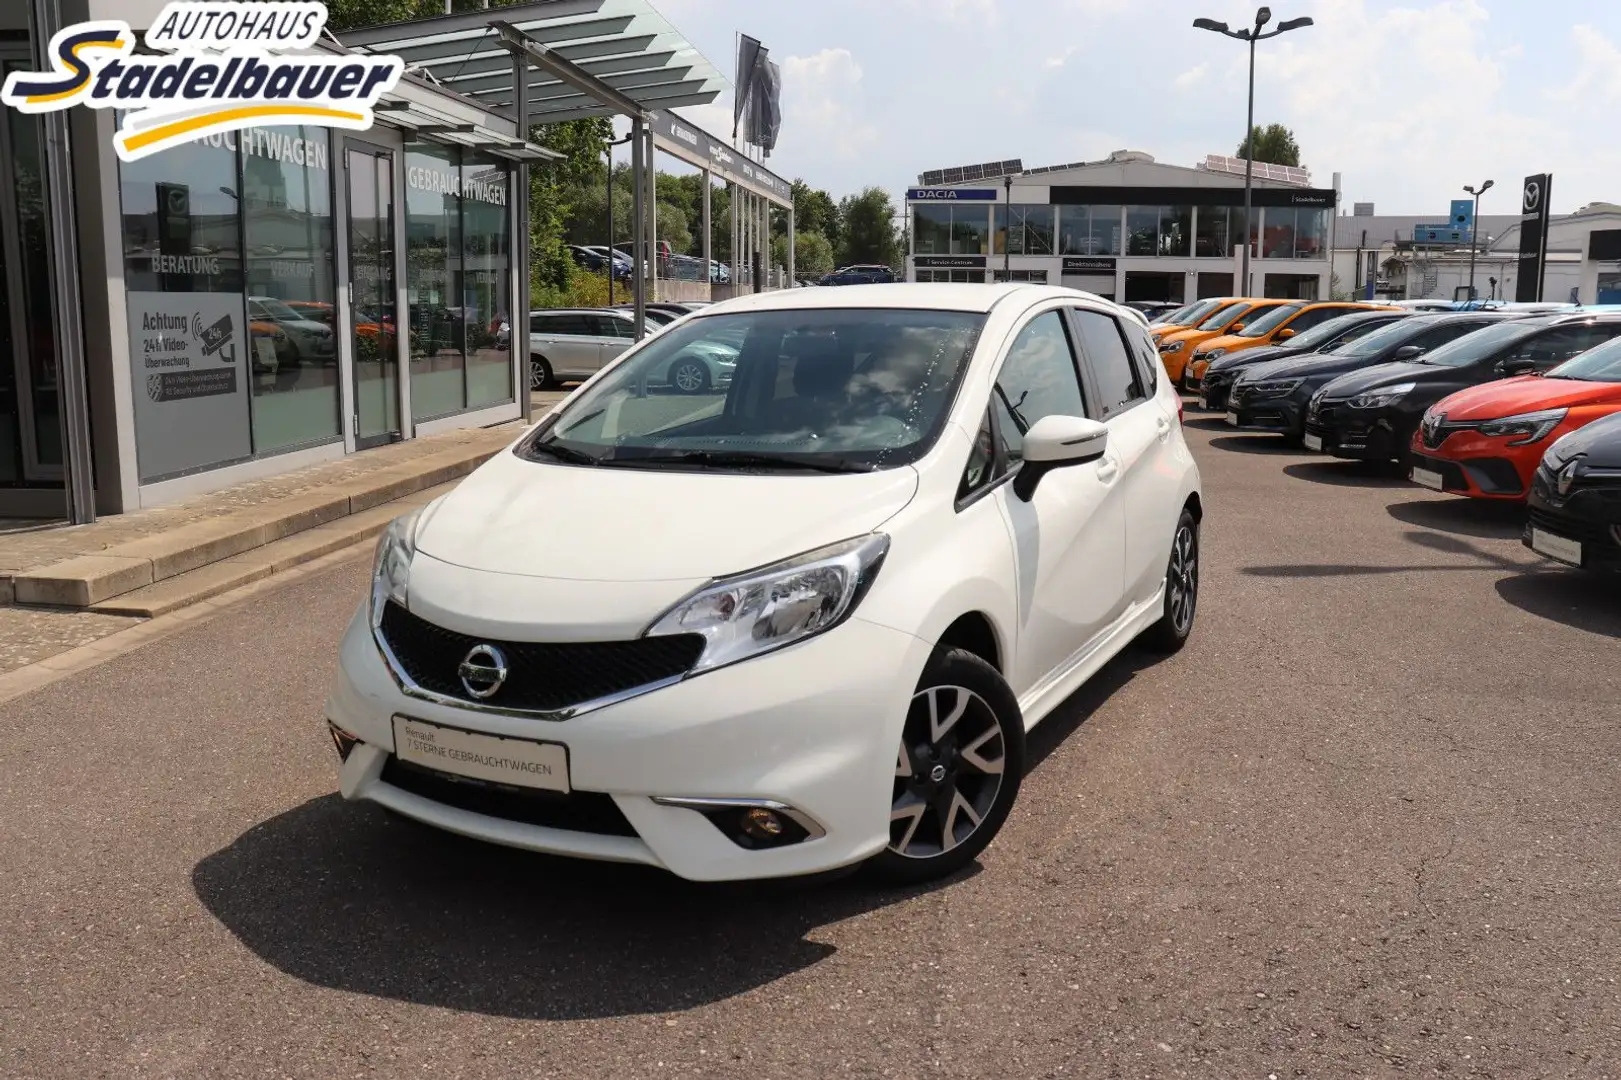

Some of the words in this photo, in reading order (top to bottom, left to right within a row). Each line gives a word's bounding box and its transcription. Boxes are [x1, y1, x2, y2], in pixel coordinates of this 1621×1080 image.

[193, 127, 327, 170] UCHTWAGEN
[408, 166, 506, 206] GEBRAUCHTWAGEN
[916, 190, 958, 199] DACIA
[151, 255, 221, 275] BERATUNG
[142, 311, 188, 334] Achtung
[208, 327, 222, 340] 24h
[163, 337, 189, 352] Video-
[144, 354, 190, 369] Überwachung
[405, 726, 436, 742] Renault
[414, 740, 447, 757] STERNE
[448, 748, 552, 775] GEBRAUCHTWAGEN
